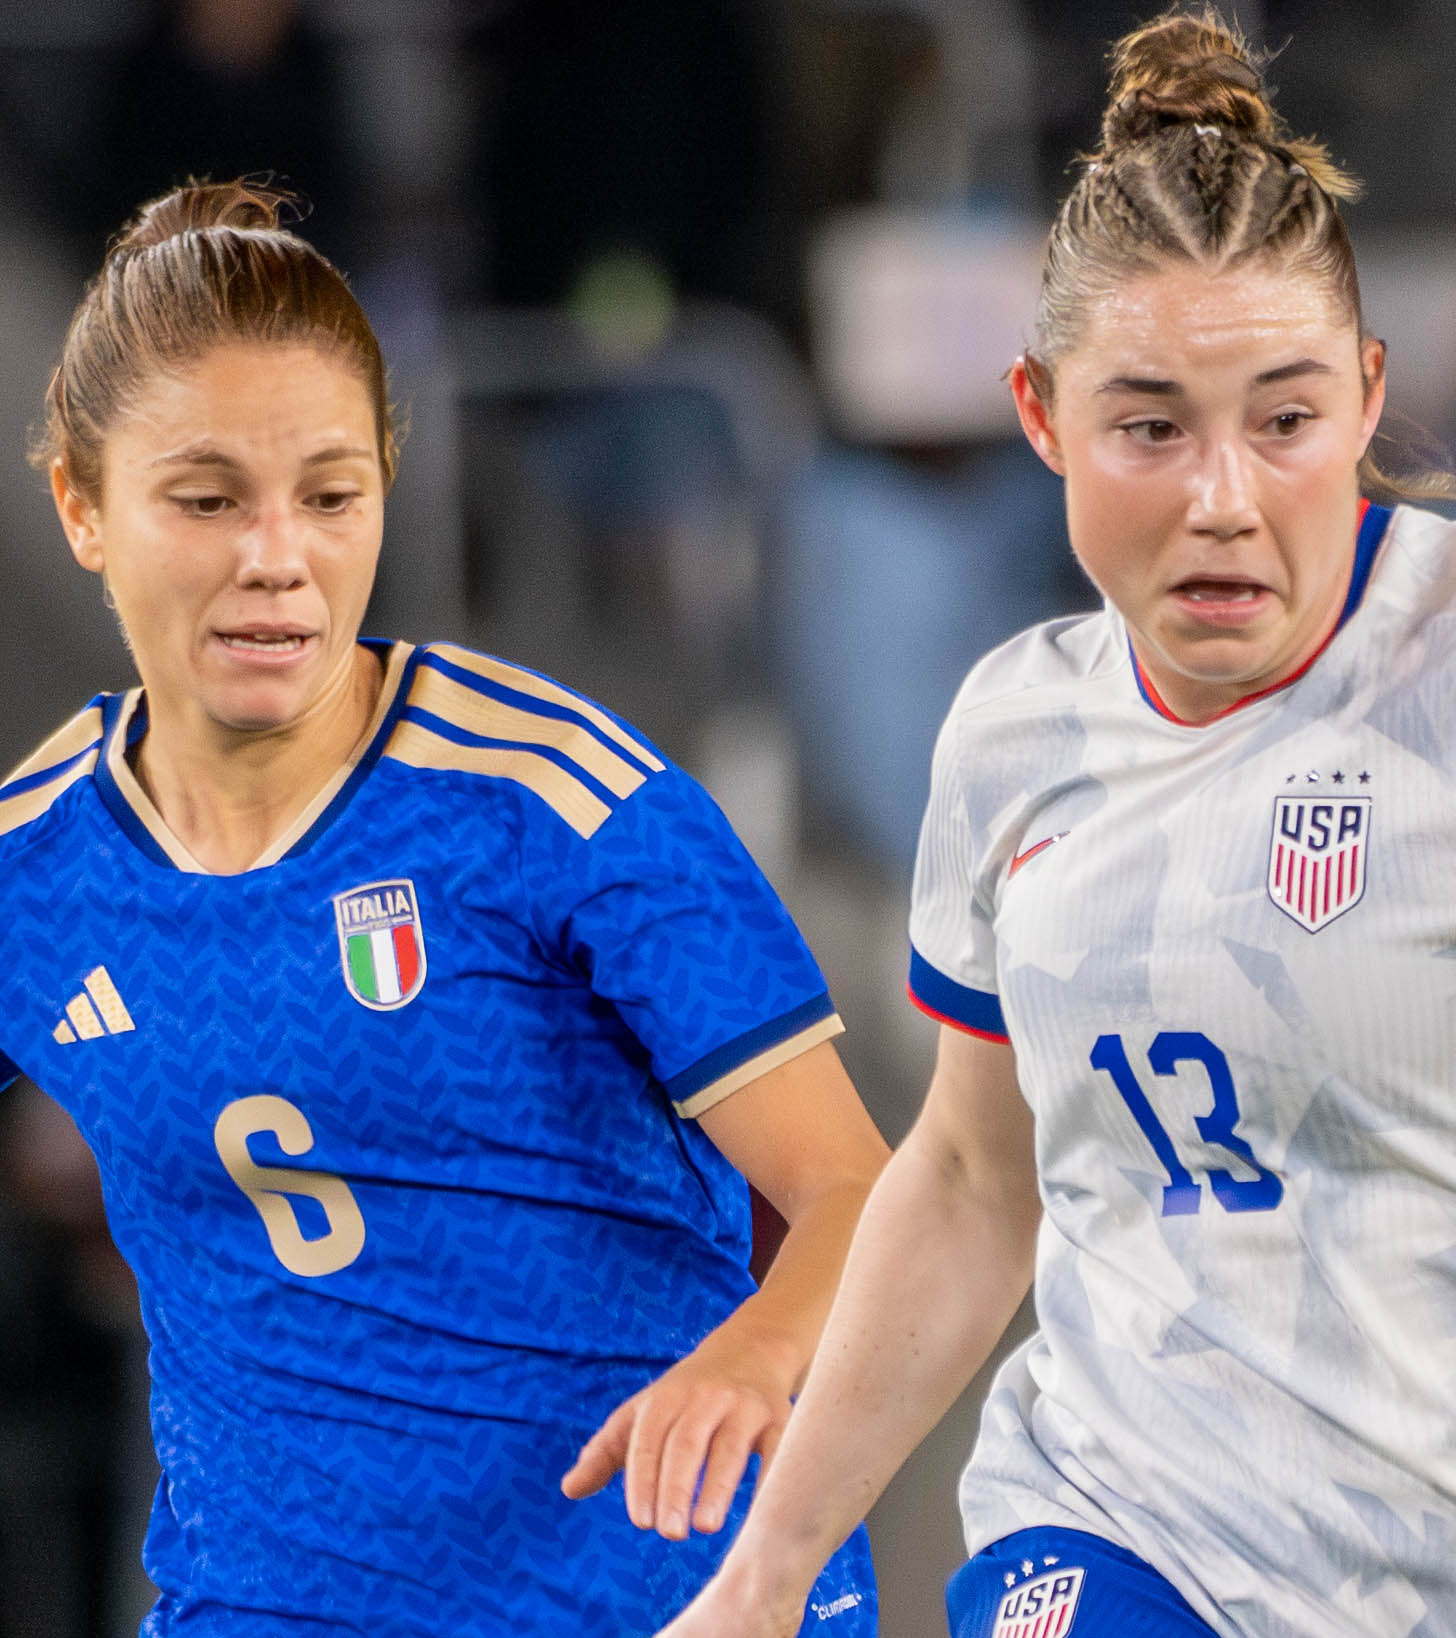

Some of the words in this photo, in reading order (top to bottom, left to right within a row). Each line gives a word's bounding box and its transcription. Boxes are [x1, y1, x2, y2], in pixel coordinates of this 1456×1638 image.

[1281, 805, 1362, 852] USA
[342, 889, 411, 926] ITALIA
[1090, 1032, 1284, 1217] 13
[214, 1094, 366, 1277] 6
[1004, 1575, 1076, 1620] USA
